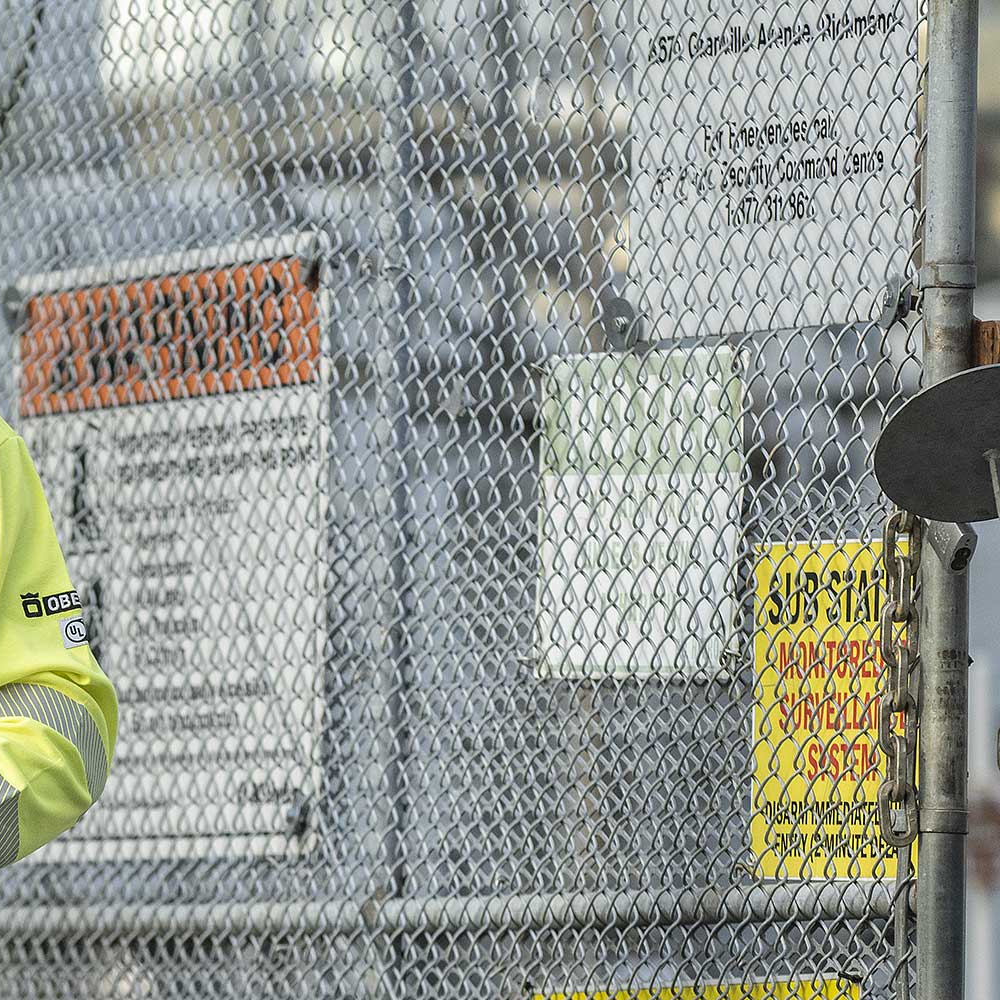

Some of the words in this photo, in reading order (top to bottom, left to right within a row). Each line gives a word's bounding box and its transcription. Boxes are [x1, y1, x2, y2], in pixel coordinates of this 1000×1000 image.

[768, 571, 819, 625] SUB
[826, 569, 891, 623] STAT
[69, 625, 84, 637] UL
[779, 640, 886, 680] MONITORED
[807, 743, 877, 782] SYSTEM
[765, 801, 808, 826] DISARM
[811, 801, 881, 826] IMMEDIATEL
[774, 833, 808, 857] ENTRY
[826, 833, 868, 858] MINUTE
